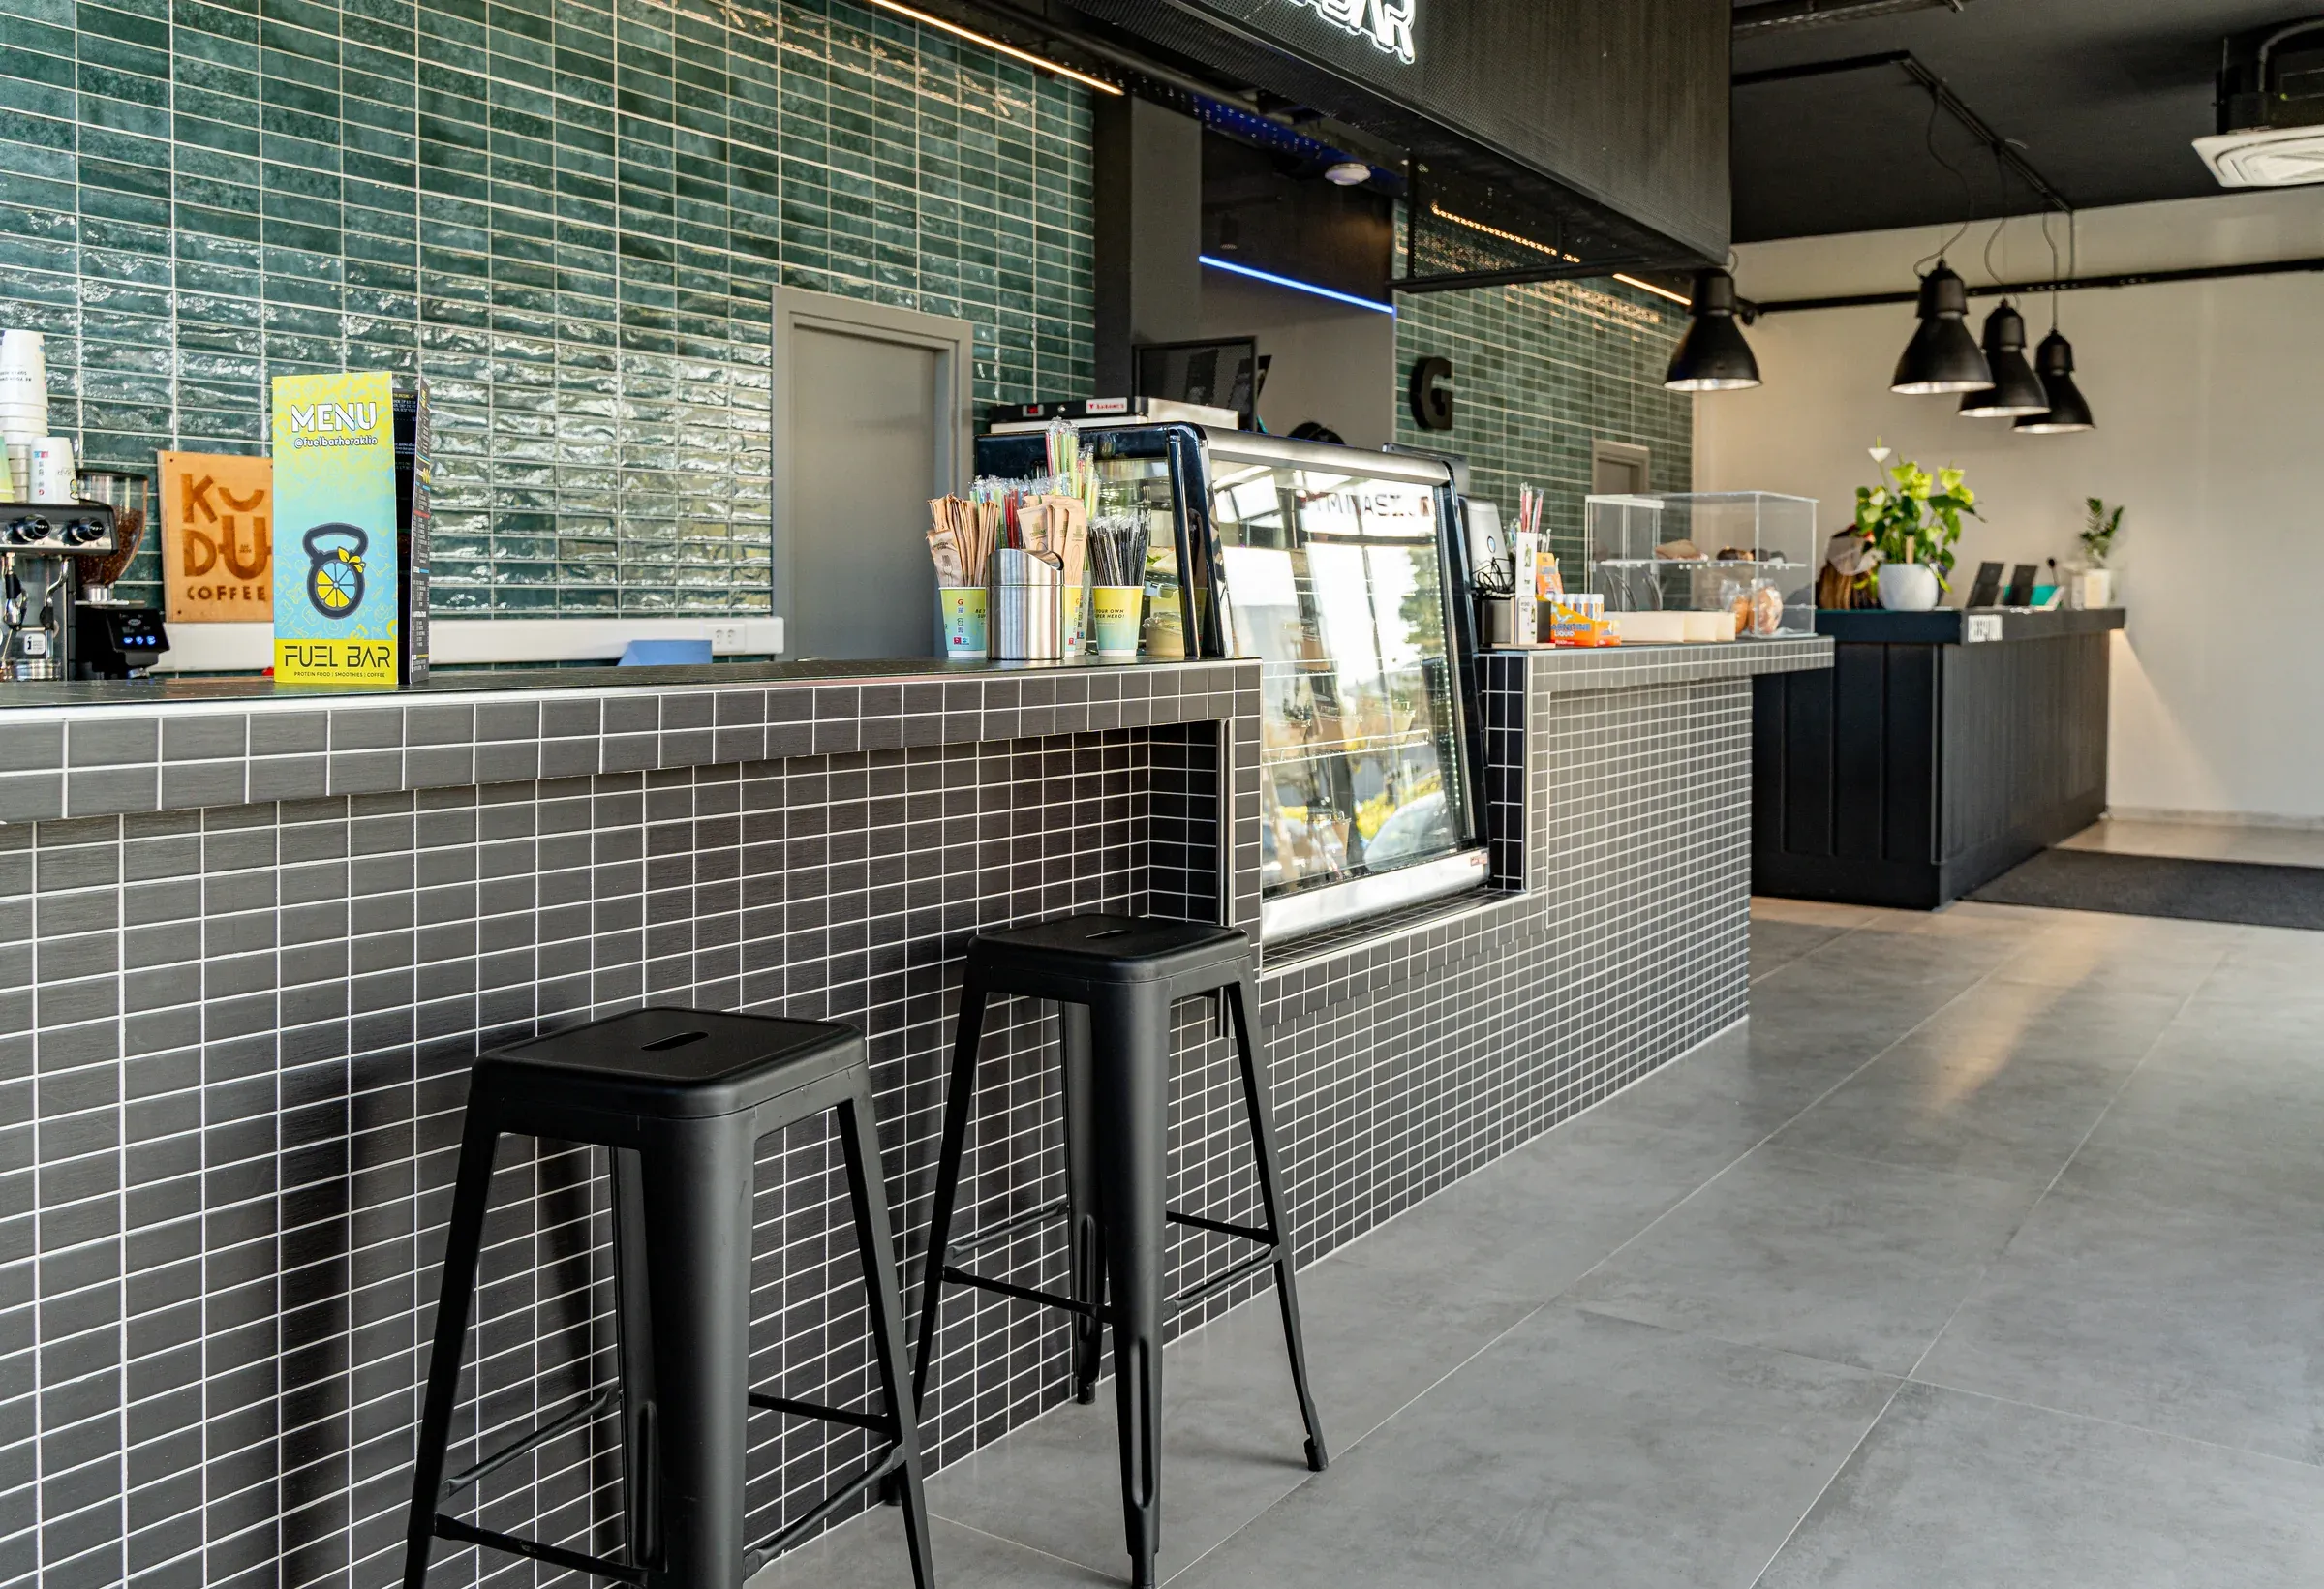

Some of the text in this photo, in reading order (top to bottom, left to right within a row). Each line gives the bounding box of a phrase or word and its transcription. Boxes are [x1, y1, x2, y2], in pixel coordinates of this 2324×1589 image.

[291, 402, 378, 433] MENU
[294, 435, 379, 449] @fuelbarheraklio
[187, 585, 267, 601] COFFEE
[284, 645, 339, 668] FUEL
[347, 645, 391, 668] BAR
